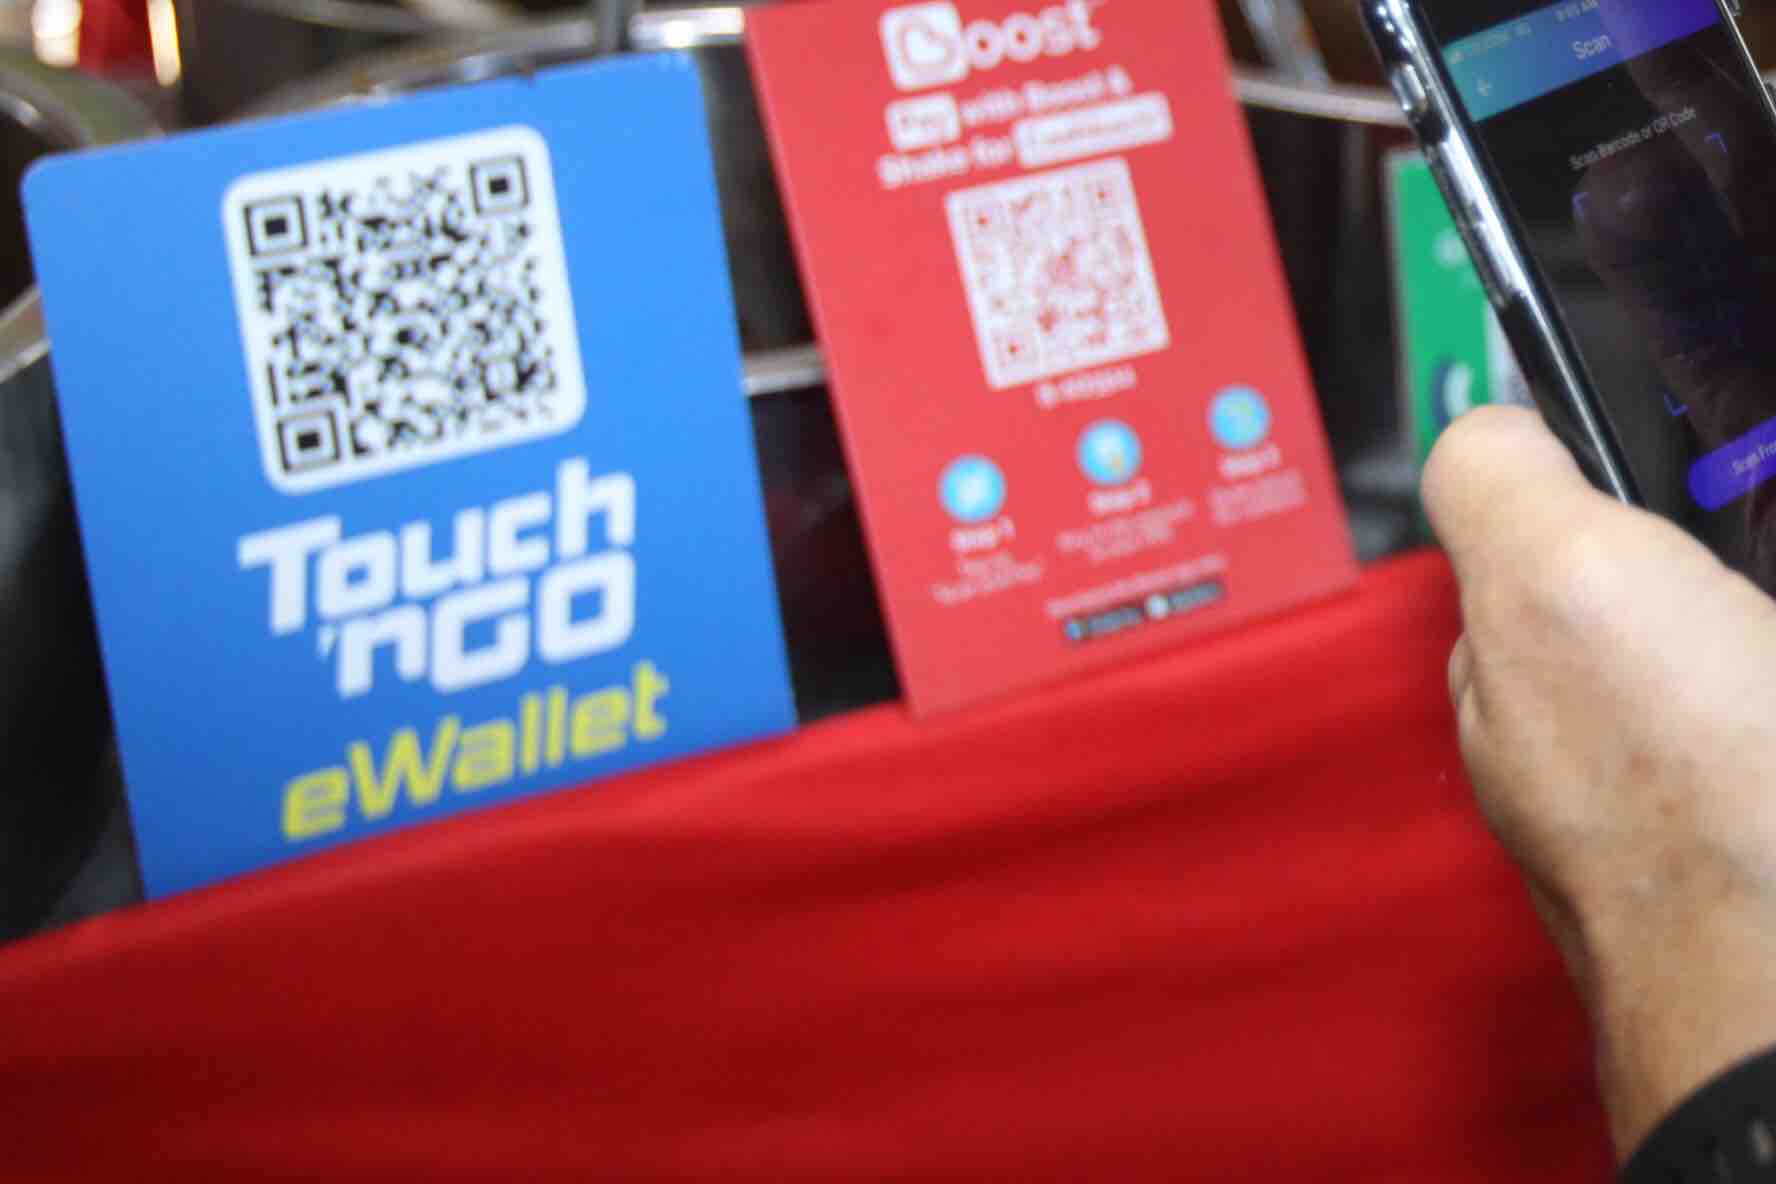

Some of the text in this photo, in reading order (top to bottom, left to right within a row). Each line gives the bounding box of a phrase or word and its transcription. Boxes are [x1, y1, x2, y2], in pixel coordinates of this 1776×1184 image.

[1571, 34, 1612, 60] Scan
[237, 456, 638, 637] Touch
[281, 659, 671, 842] eWallet
